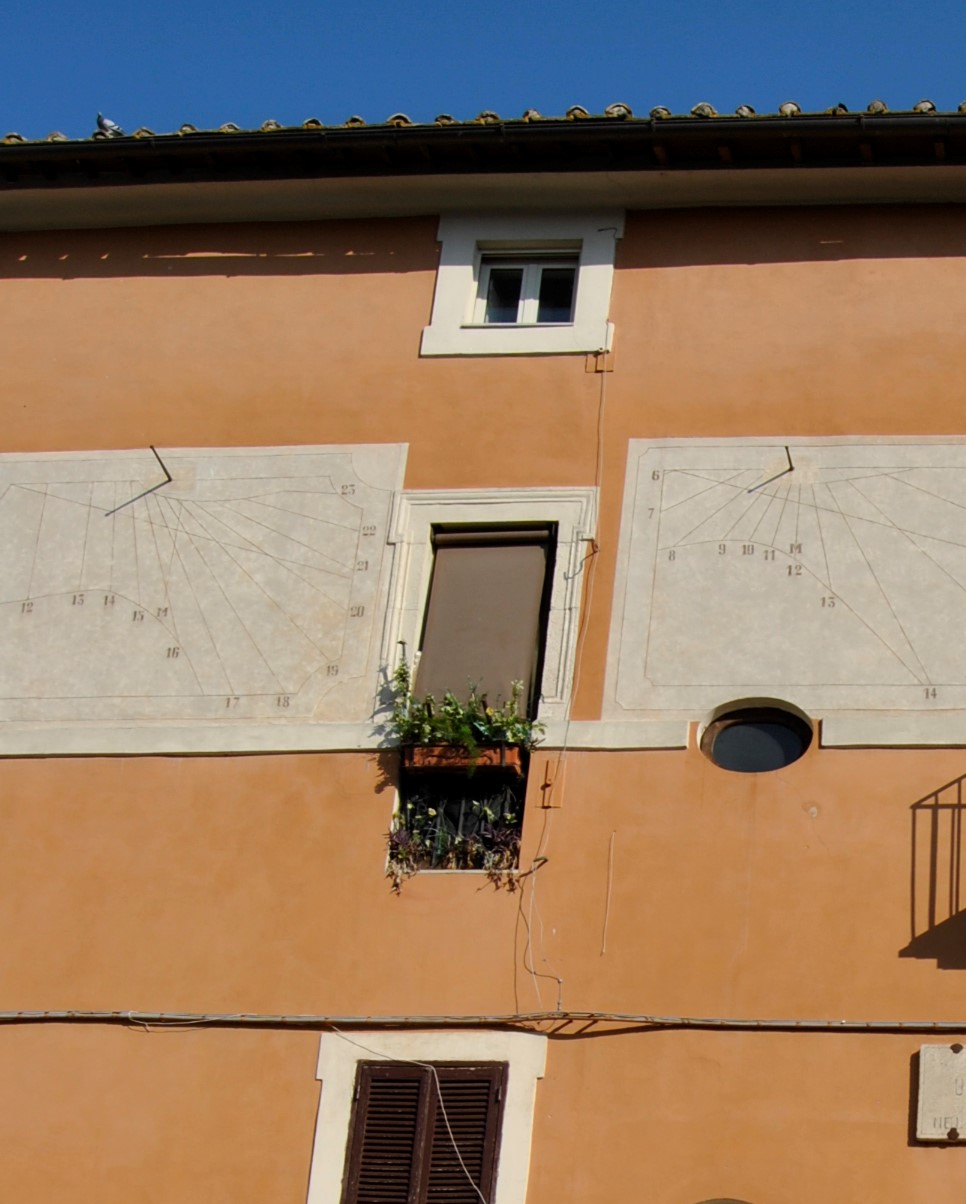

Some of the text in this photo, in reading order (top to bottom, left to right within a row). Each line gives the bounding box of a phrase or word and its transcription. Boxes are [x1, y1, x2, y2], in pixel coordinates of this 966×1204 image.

[652, 470, 659, 481] 6
[648, 508, 655, 519] 7
[718, 544, 726, 555] 9
[742, 544, 754, 555] 10
[790, 543, 802, 554] M
[668, 550, 676, 561] 8
[764, 550, 775, 561] 11
[356, 561, 369, 571] 21
[787, 565, 802, 576] 12
[72, 594, 84, 606] 13
[104, 595, 115, 606] 14
[821, 597, 835, 608] 13
[21, 602, 33, 613] 12
[350, 606, 364, 617] 20
[132, 611, 144, 622] 15
[166, 647, 180, 659] 16
[326, 665, 339, 677] 19
[923, 688, 937, 699] 14
[225, 697, 240, 708] 17
[276, 696, 290, 707] 18
